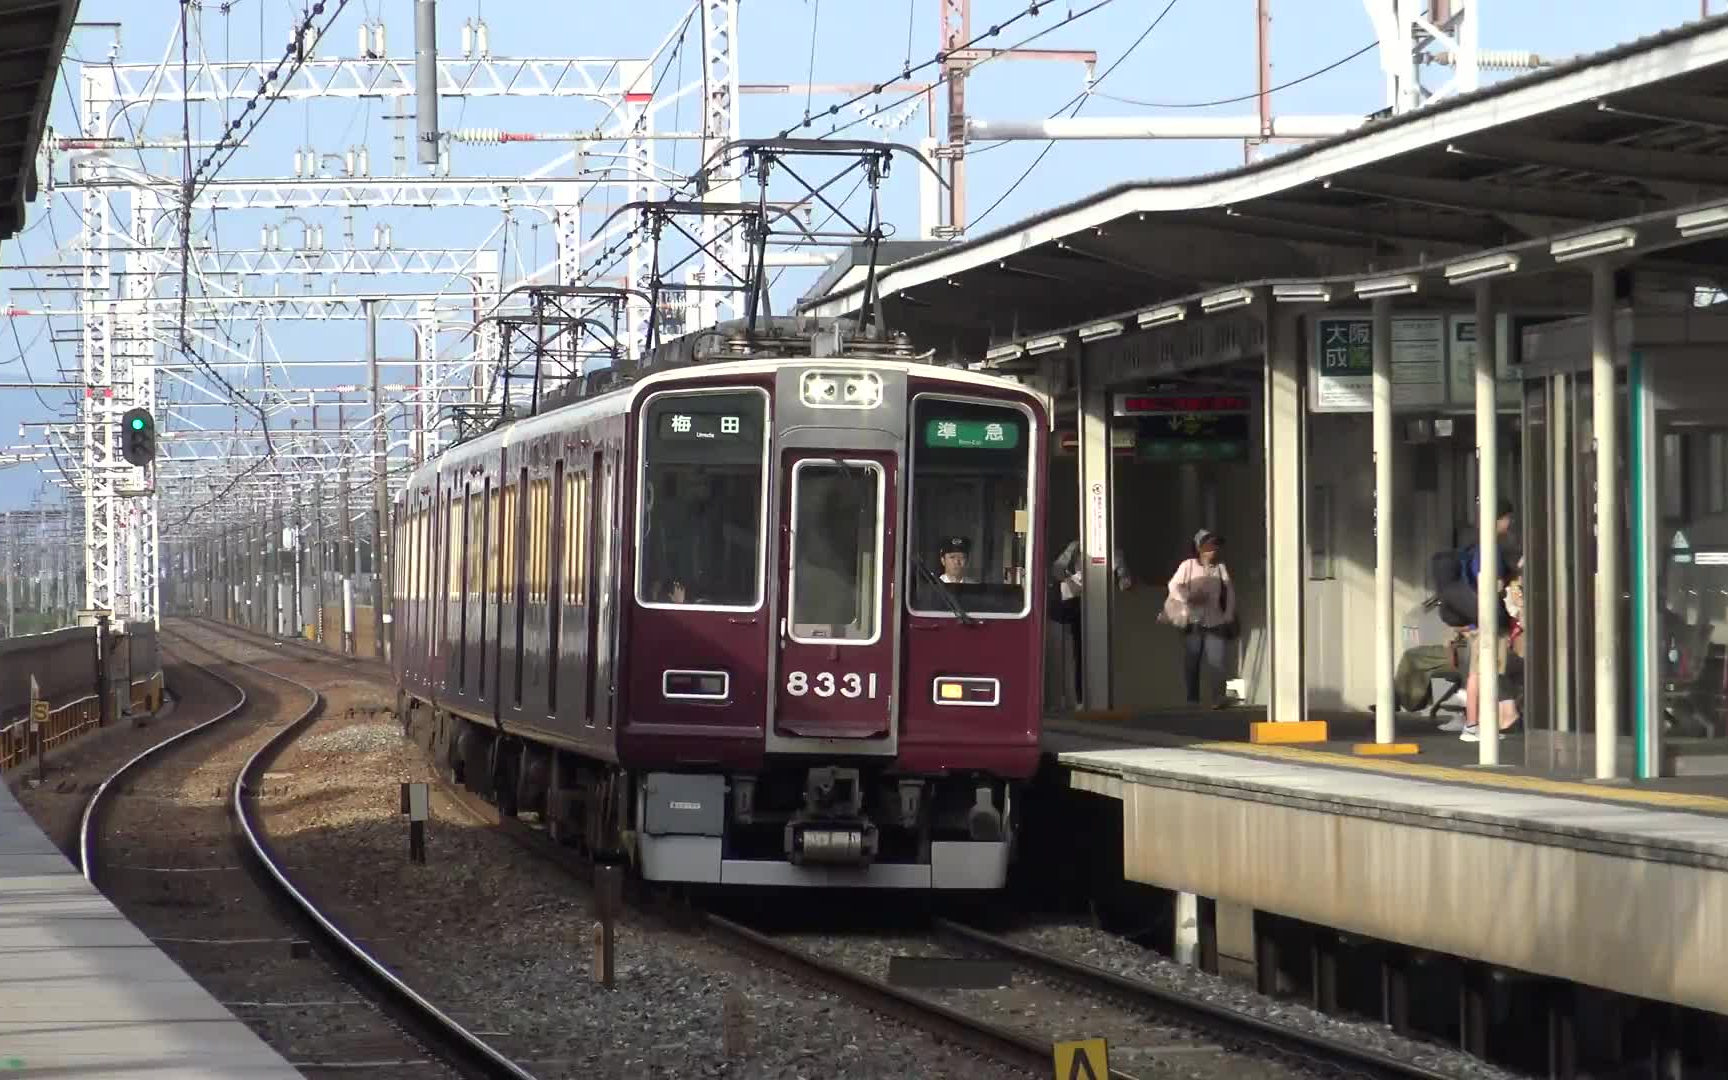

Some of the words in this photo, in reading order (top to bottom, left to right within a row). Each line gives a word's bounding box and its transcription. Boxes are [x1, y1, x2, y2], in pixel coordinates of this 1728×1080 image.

[1326, 323, 1371, 344] 大阪
[671, 414, 739, 433] 梅田
[937, 422, 1004, 441] 準急
[787, 671, 876, 699] 8331
[35, 704, 47, 720] S
